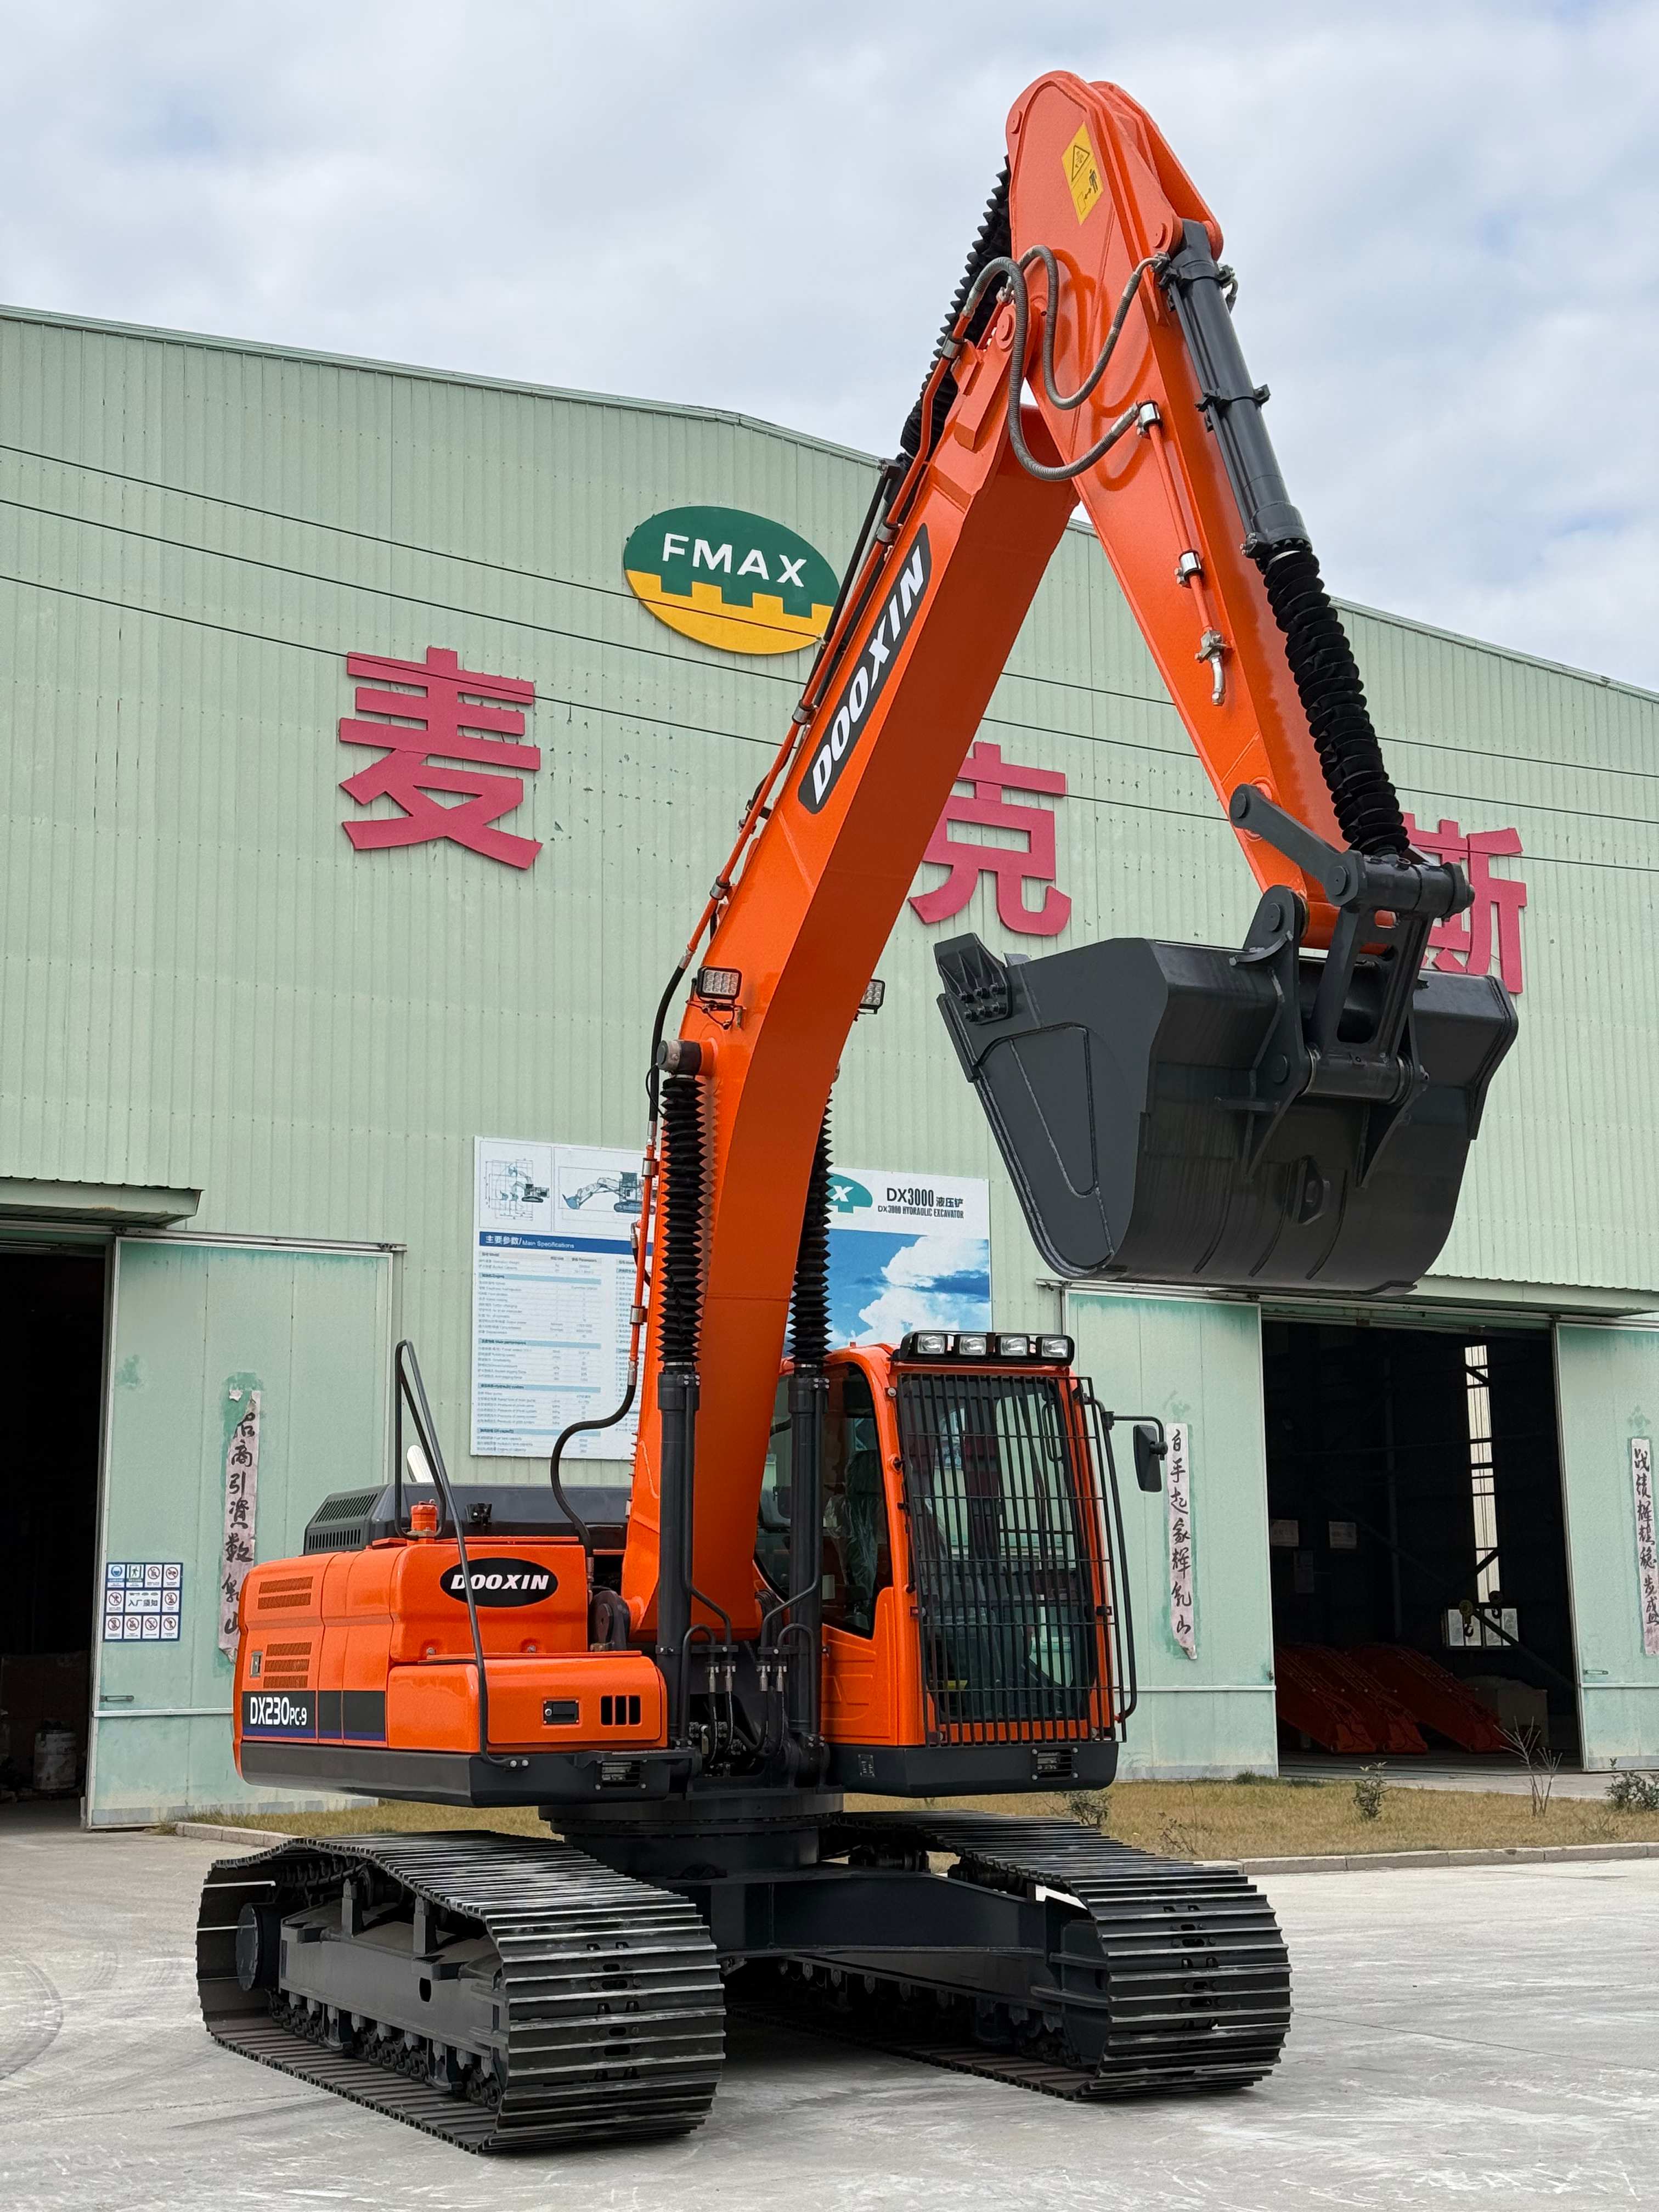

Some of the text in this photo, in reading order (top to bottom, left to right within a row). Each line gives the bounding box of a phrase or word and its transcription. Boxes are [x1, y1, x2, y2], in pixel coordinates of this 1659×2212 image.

[662, 533, 807, 588] FMAX
[812, 545, 924, 805] DOOXIN
[887, 1187, 964, 1207] DX3000 液压铲
[878, 1205, 964, 1218] DX3000 HYDRAULIC EXCAVATOR
[537, 1240, 575, 1249] Specifications
[450, 1574, 549, 1590] DOOXIN
[128, 1599, 158, 1607] 入厂须知
